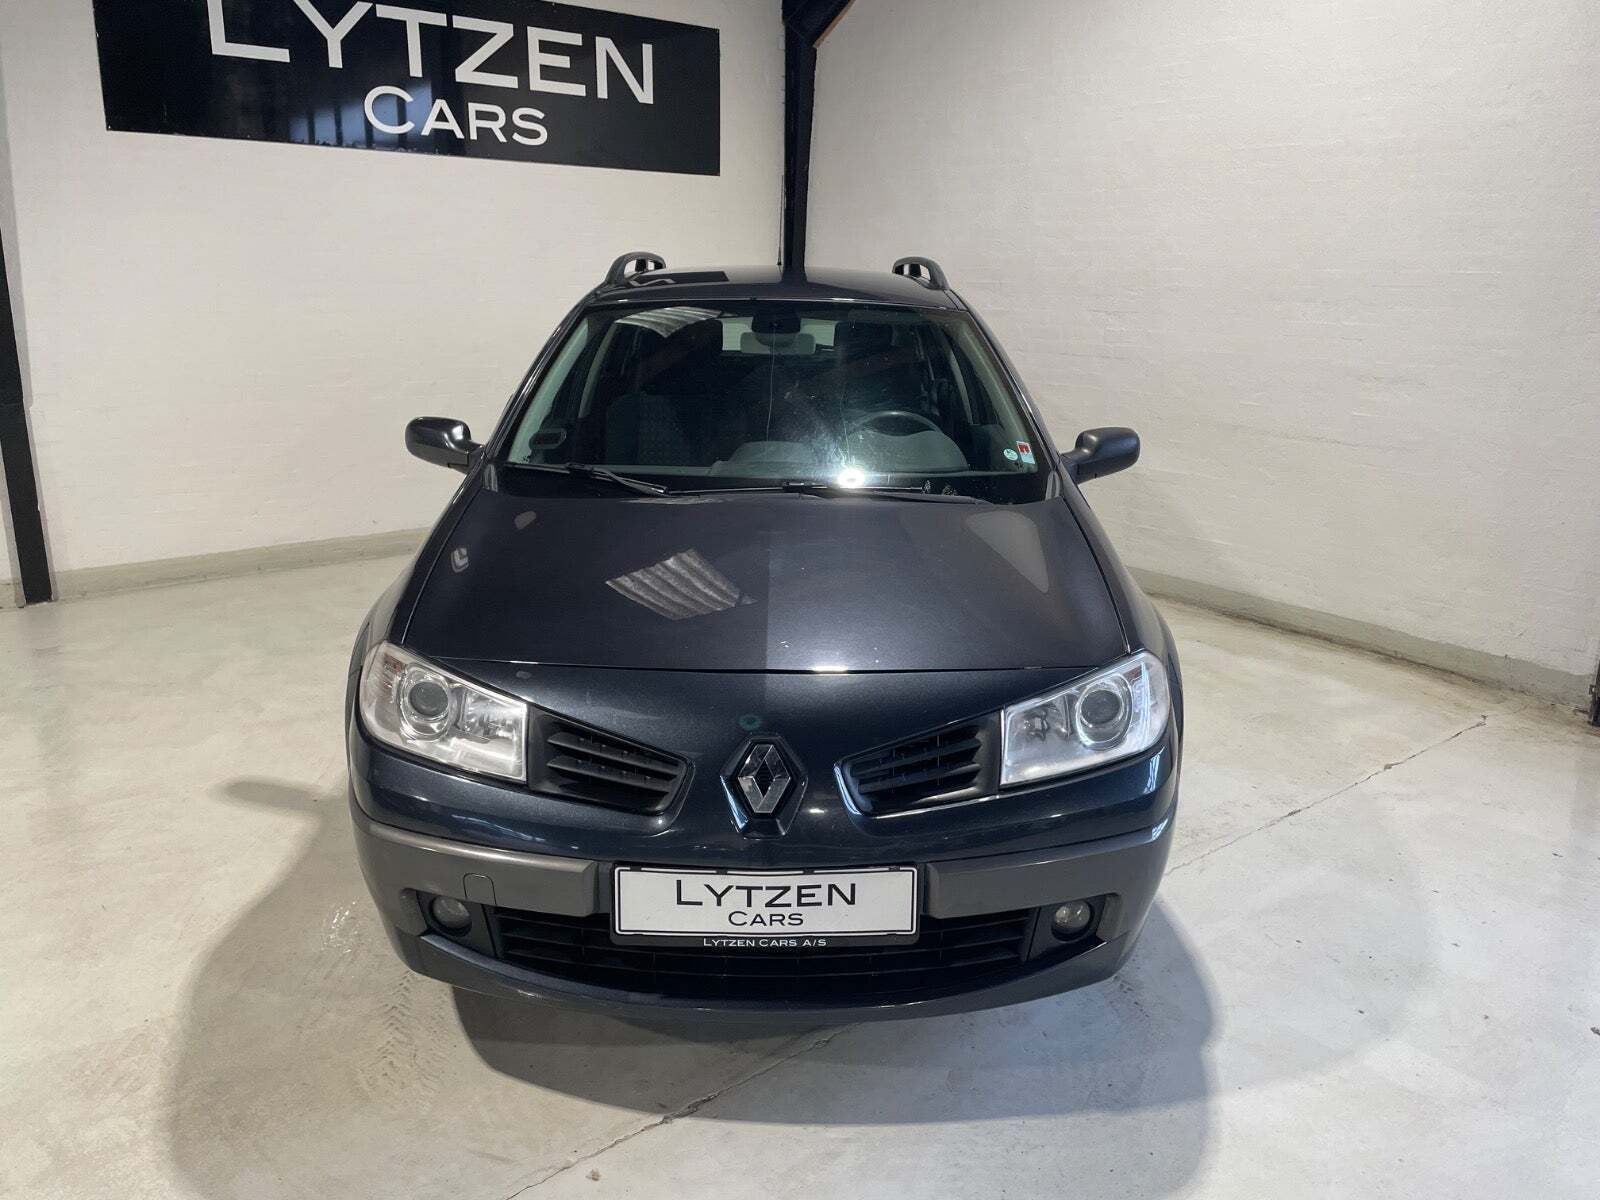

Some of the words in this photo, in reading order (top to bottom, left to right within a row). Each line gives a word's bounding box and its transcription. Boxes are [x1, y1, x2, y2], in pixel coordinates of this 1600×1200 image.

[207, 0, 654, 105] LYTZEN
[364, 85, 549, 146] CARS
[676, 879, 857, 908] LYTZEN
[728, 910, 805, 927] CARS
[703, 937, 756, 948] LYTZEN
[759, 938, 798, 948] CARS
[802, 938, 827, 948] A/S
